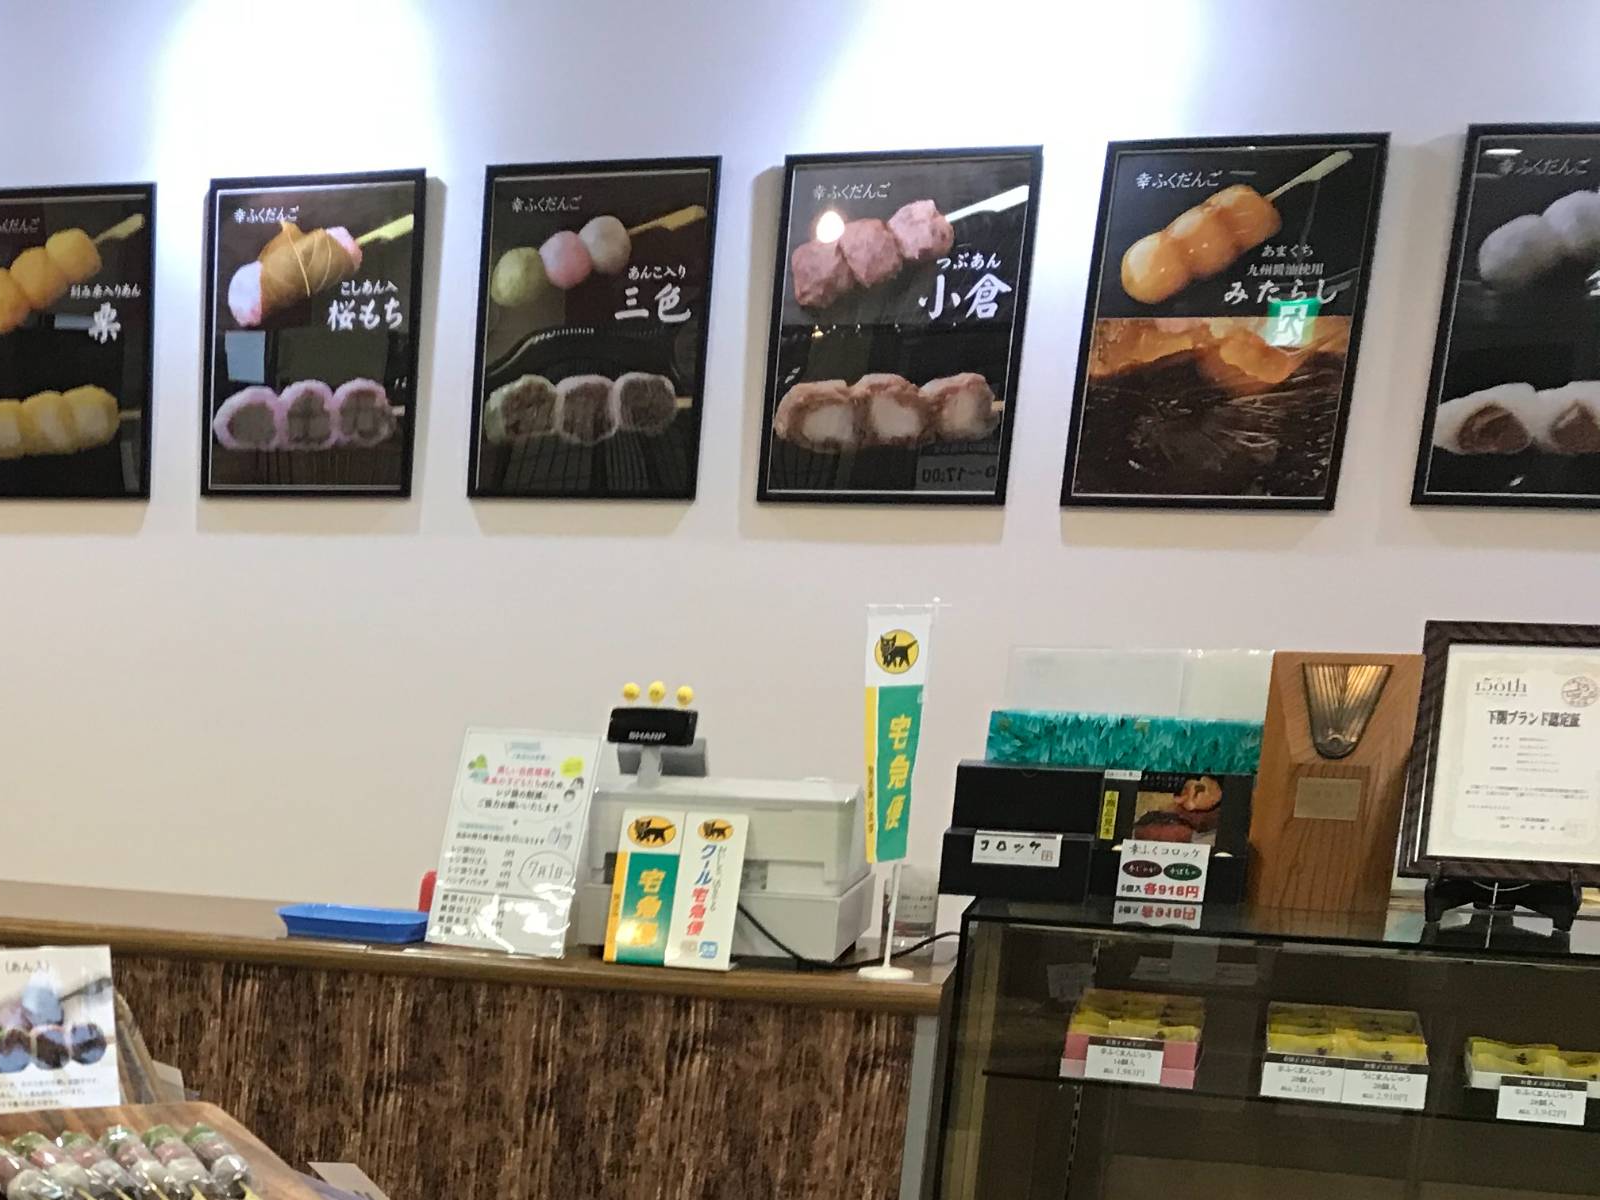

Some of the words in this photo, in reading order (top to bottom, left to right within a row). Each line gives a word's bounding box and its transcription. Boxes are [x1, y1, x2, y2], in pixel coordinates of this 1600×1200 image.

[1135, 170, 1223, 191] 幸ふくだんご
[812, 181, 892, 201] 幸ふくだんご
[511, 194, 583, 214] 幸ふくだんご
[233, 205, 300, 224] 幸ふくだんご
[1261, 244, 1314, 258] あまくち
[935, 252, 1002, 271] つぶあん
[627, 264, 687, 281] あんこ入り
[918, 274, 1013, 320] 小倉
[1223, 279, 1339, 305] みたらし
[613, 284, 692, 323] 三色
[327, 297, 403, 332] 桜もち
[1488, 710, 1581, 728] 下関ブランド認定証
[628, 730, 667, 742] SHARP
[884, 713, 912, 832] 宅急便
[980, 839, 1042, 852] コロッケ
[1129, 842, 1200, 858] 幸ふくコロッケ
[1143, 882, 1200, 898] 各918円
